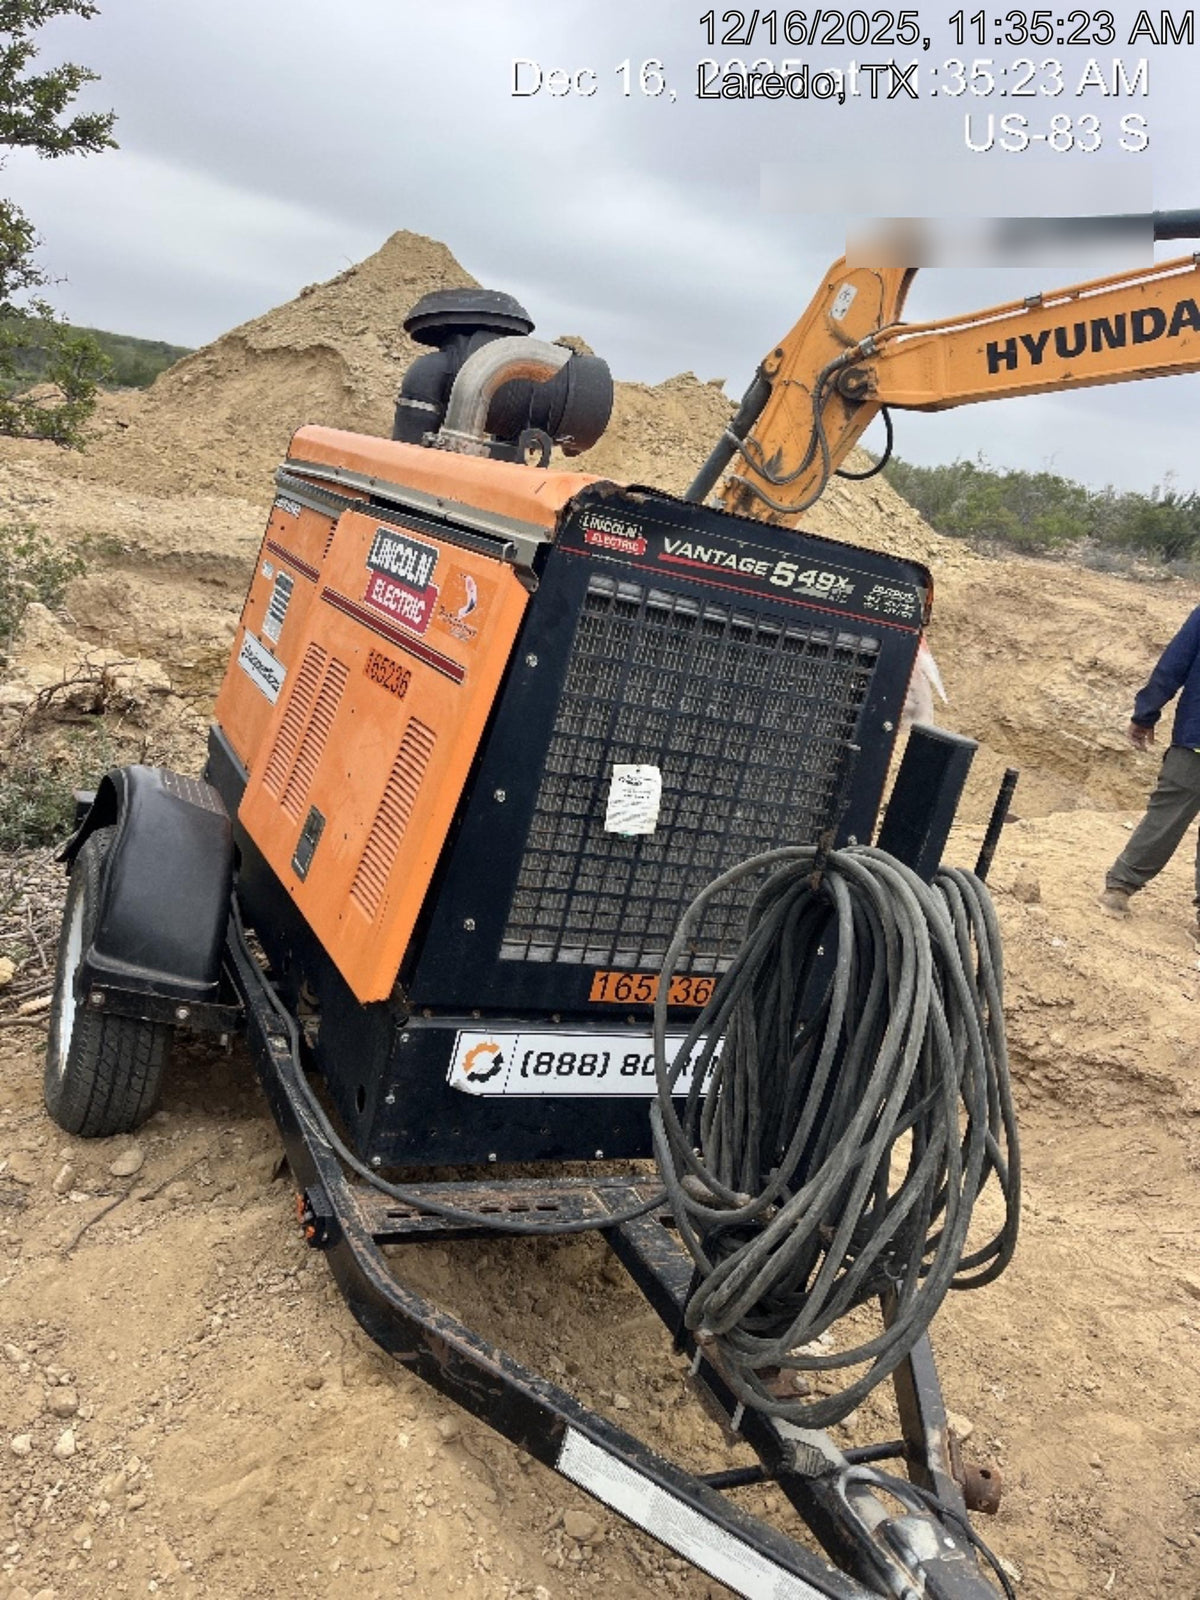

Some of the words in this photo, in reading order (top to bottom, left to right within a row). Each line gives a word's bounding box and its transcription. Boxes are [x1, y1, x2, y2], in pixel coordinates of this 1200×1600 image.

[583, 515, 638, 539] LINCOLN
[592, 532, 640, 553] ELECTRIC
[369, 534, 433, 588] LINCOLN
[663, 536, 774, 577] VANTAGE
[371, 578, 427, 625] ELECTRIC
[598, 973, 713, 1006] 16536
[520, 1050, 611, 1078] (888)
